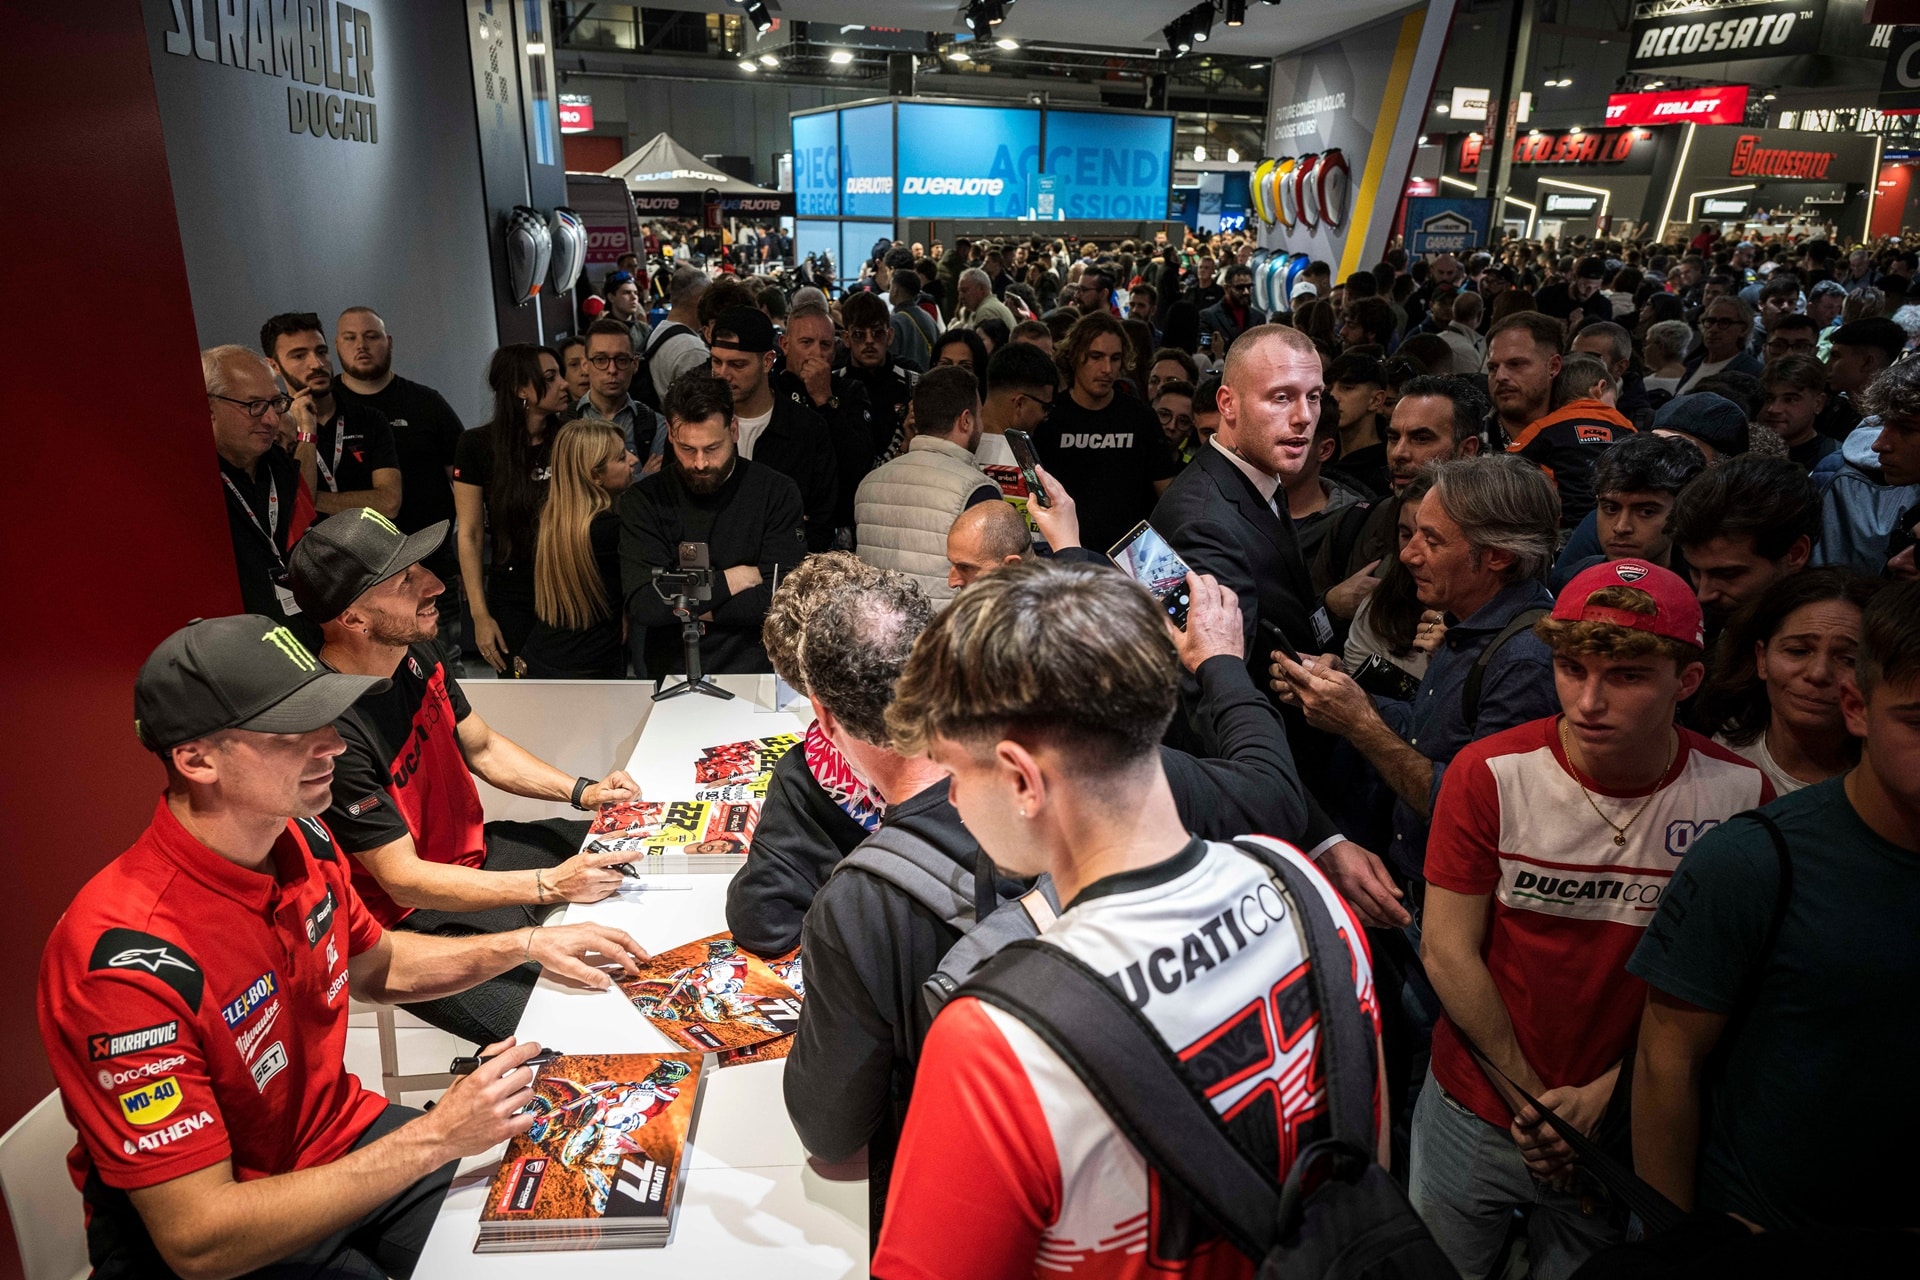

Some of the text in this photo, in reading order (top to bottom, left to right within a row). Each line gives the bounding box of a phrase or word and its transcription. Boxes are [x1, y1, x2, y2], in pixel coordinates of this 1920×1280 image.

[165, 0, 375, 97] SCRAMBLER
[1636, 12, 1796, 59] ACCOSSATO
[288, 87, 378, 144] DUCATI
[1295, 100, 1316, 117] COMES
[1653, 99, 1721, 115] ITALJET
[1513, 133, 1636, 162] CCOSSATO
[1749, 149, 1832, 180] ACCOSSATO
[1425, 236, 1466, 249] GARAGE
[1060, 433, 1134, 449] DUCATI
[110, 1021, 177, 1056] AKRAPOVIČ
[236, 999, 281, 1060] Milwaukee
[123, 1082, 175, 1113] WD-40
[138, 1110, 214, 1150] ATHENA
[616, 1159, 655, 1203] 77
[649, 1165, 667, 1202] LUPINO
